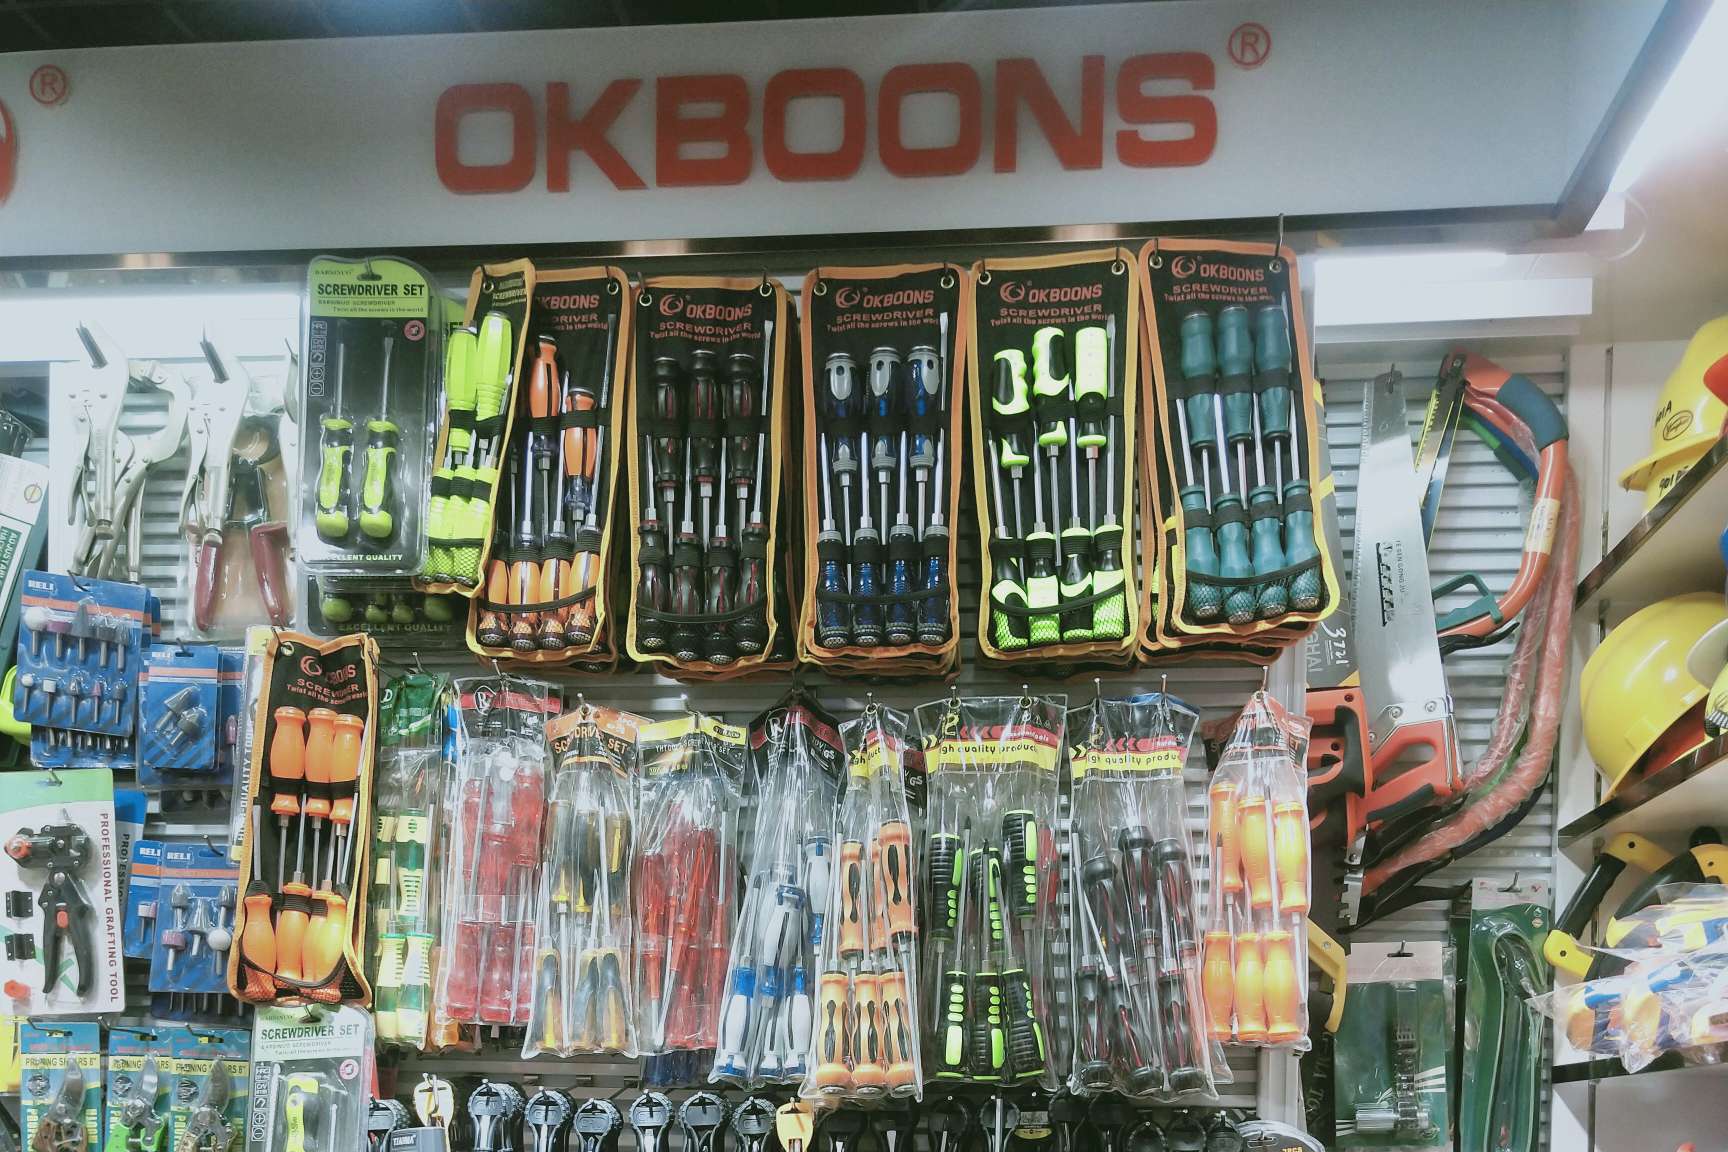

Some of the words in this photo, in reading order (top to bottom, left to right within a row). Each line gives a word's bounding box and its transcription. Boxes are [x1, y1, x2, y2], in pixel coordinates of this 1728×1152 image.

[434, 51, 1218, 194] OKBOONS
[1200, 264, 1265, 282] OKBOONS
[318, 283, 398, 296] SCREWDRIVER
[403, 284, 425, 296] SET
[863, 289, 935, 308] OKBOONS
[1028, 284, 1103, 304] OKBOONS
[1173, 283, 1268, 296] SCREWDRIVER
[538, 294, 600, 310] KBOONS
[1000, 303, 1102, 318] SCREWDRIVER
[686, 303, 753, 321] OKBOONS
[836, 307, 935, 324] SCREWDRIVER
[659, 321, 753, 336] SCREWDRIVER
[365, 554, 403, 562] QUALITY
[607, 737, 628, 755] SET
[100, 812, 113, 902] PROFESSIONAL
[105, 907, 118, 967] GRAFTING
[109, 971, 119, 1002] TOOL
[261, 1025, 334, 1041] SCREWDRIVER
[339, 1024, 360, 1037] SET
